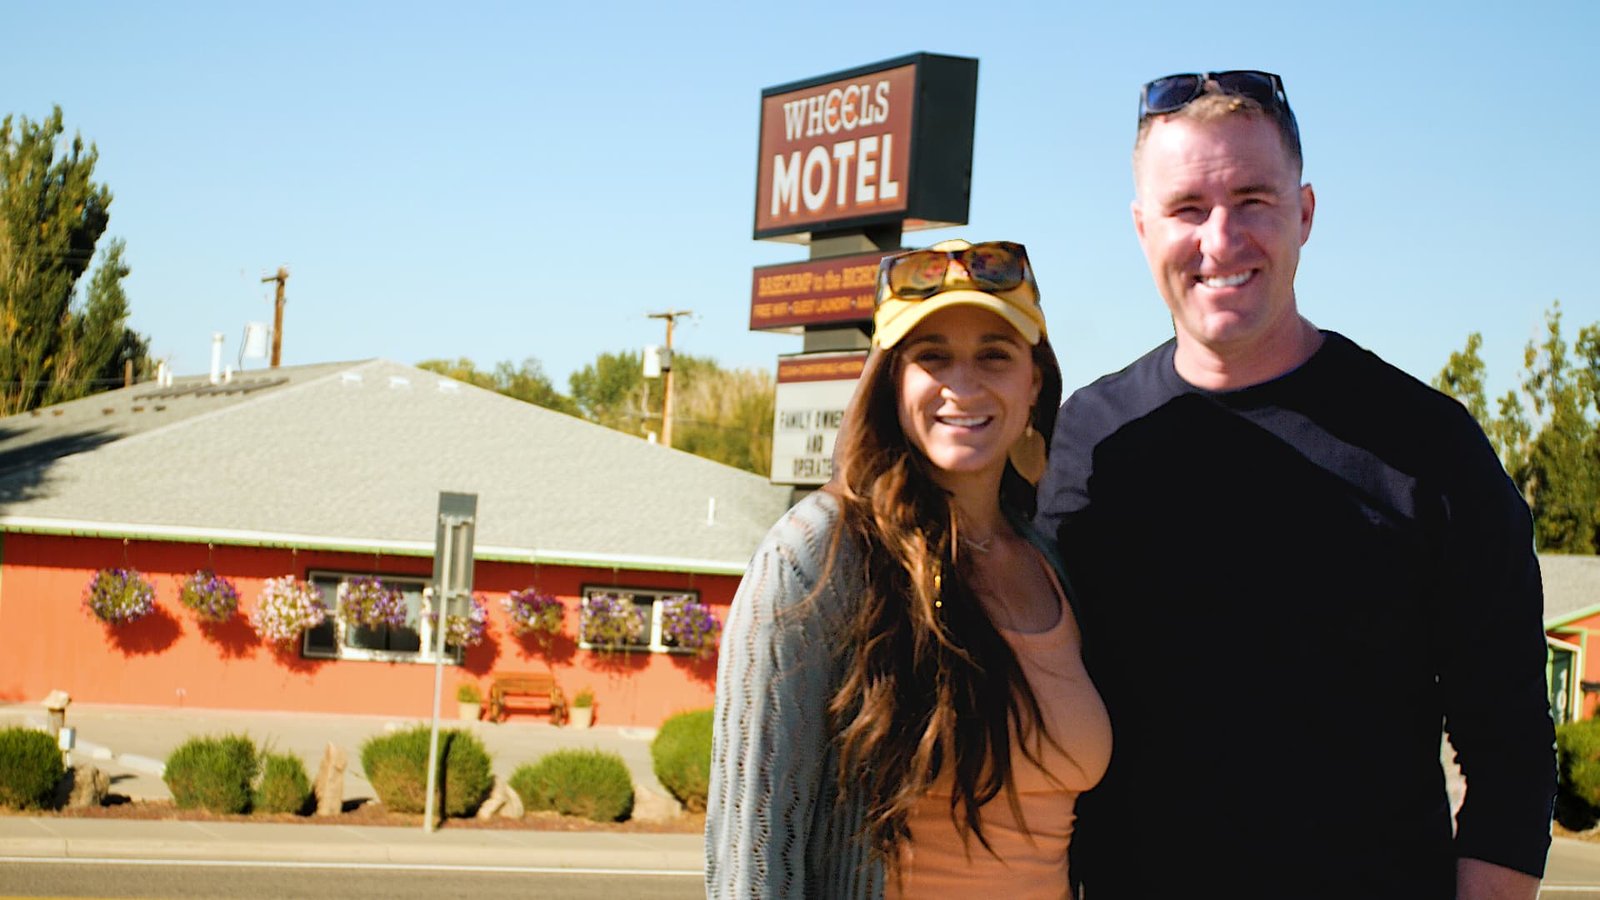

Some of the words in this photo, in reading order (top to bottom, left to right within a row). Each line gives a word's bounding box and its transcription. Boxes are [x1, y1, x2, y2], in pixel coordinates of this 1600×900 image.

[783, 81, 890, 141] WHEELS
[771, 134, 898, 216] MOTEL
[824, 269, 841, 291] the
[780, 409, 811, 429] FAMILY
[806, 433, 823, 454] AND
